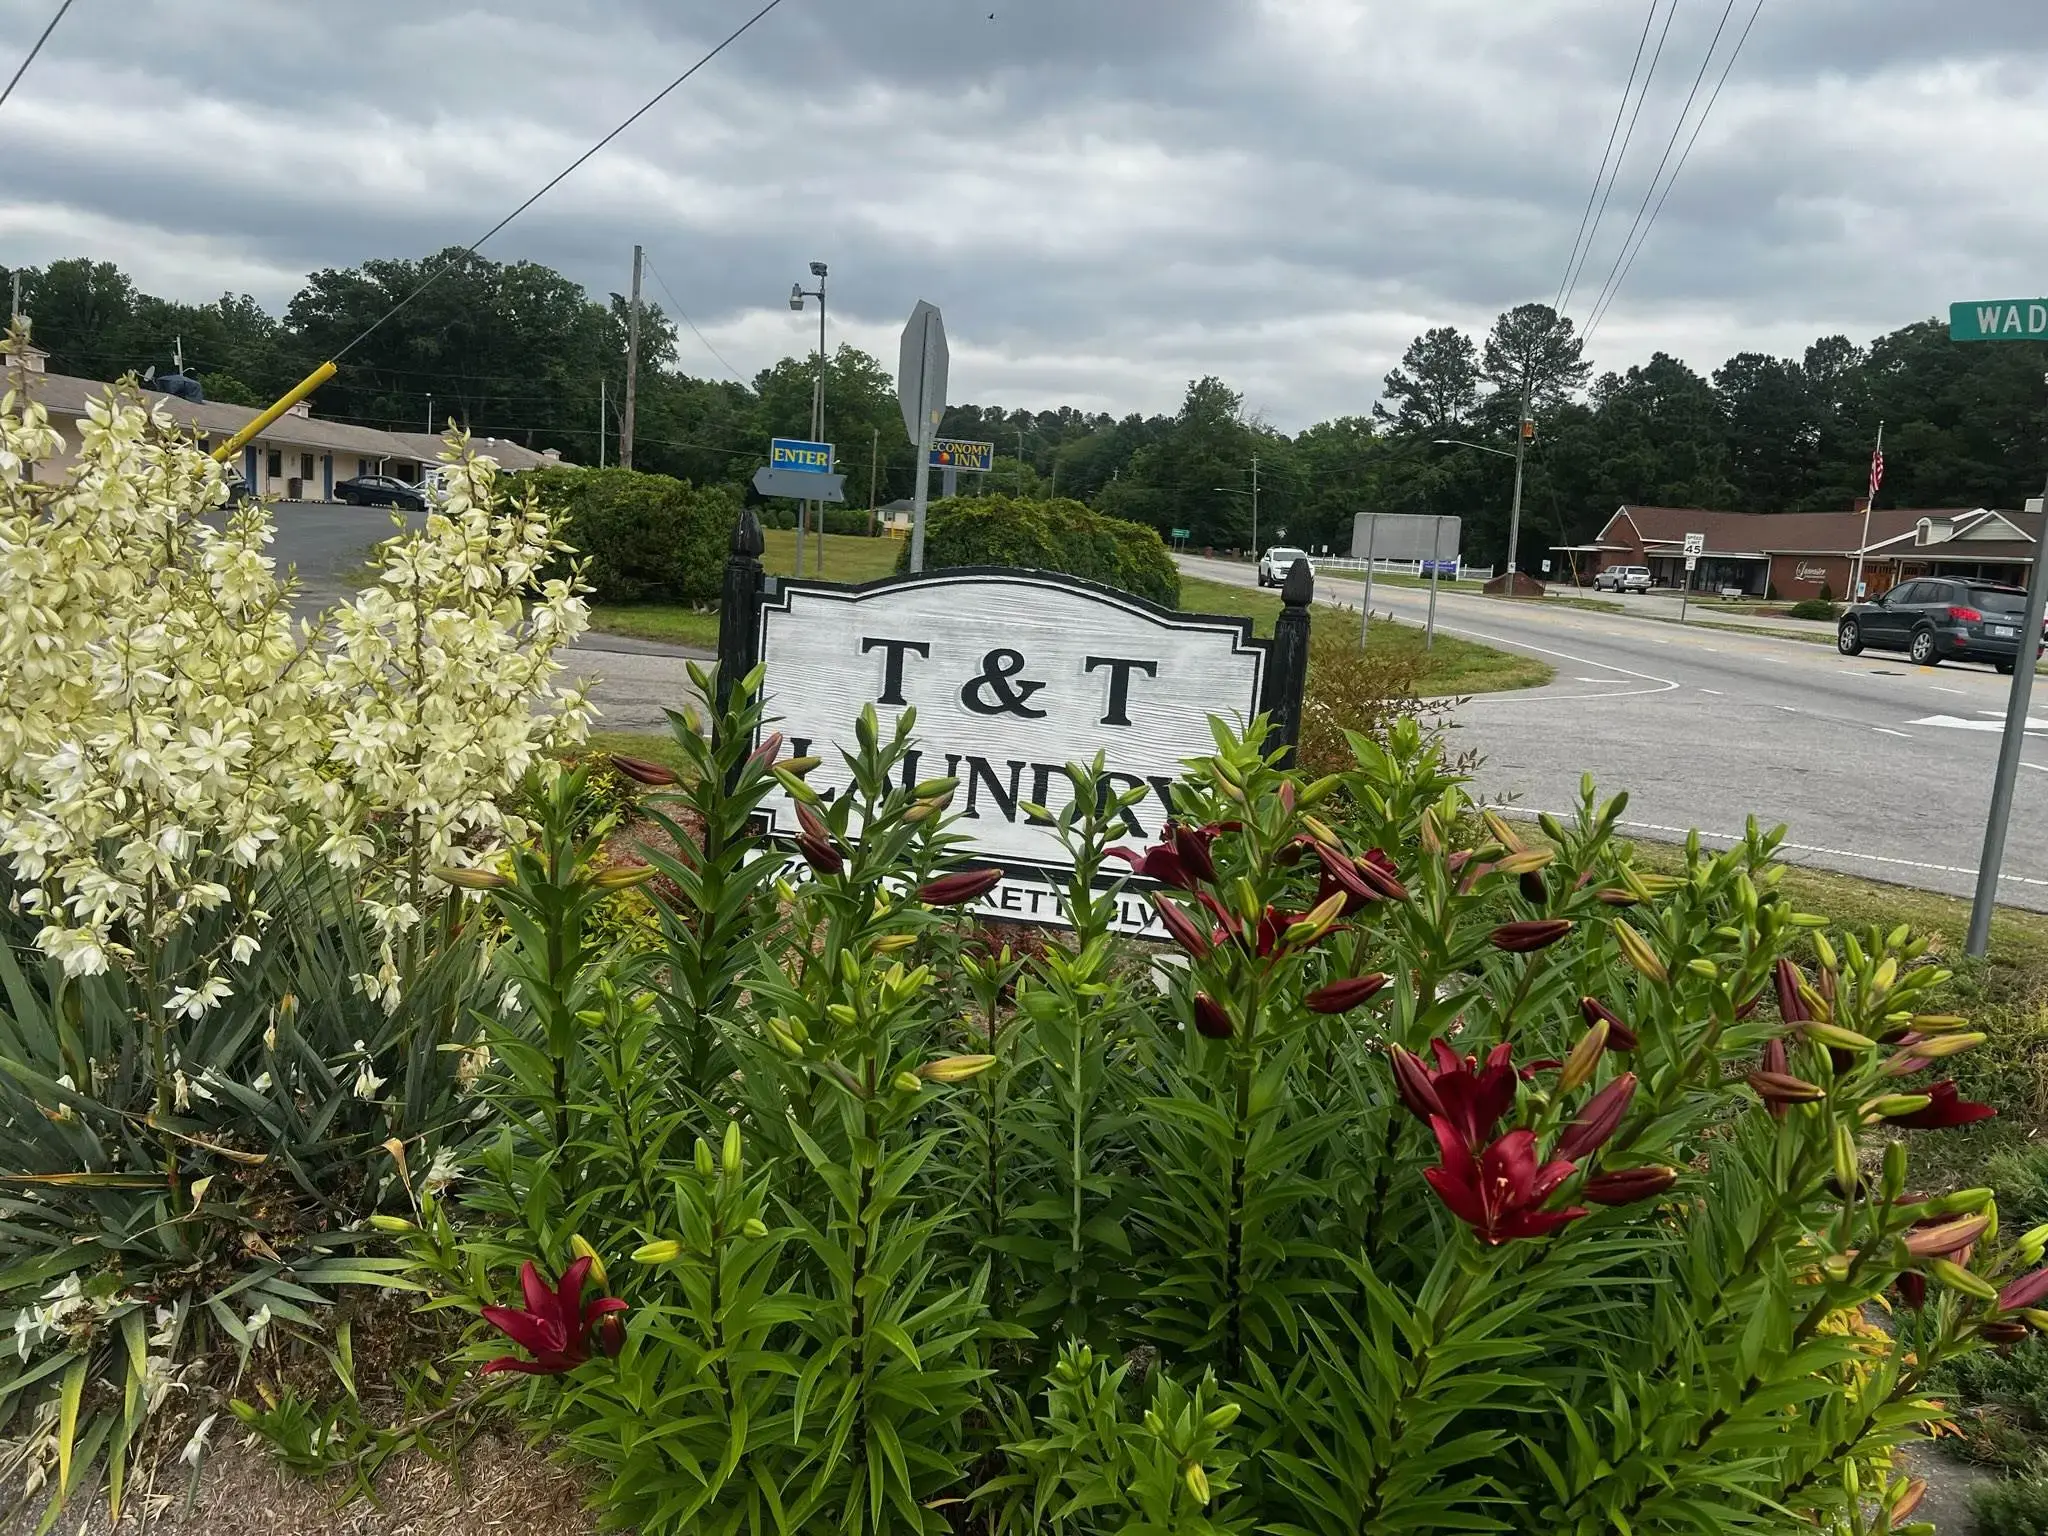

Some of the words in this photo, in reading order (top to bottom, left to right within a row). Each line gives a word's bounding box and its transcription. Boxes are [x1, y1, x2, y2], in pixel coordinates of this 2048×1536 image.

[930, 441, 990, 456] ECONOMY
[774, 447, 828, 467] ENTER
[954, 453, 982, 468] INN
[1685, 545, 1701, 554] 45
[862, 636, 930, 706] T
[960, 648, 1048, 719] &
[1084, 655, 1158, 727] T
